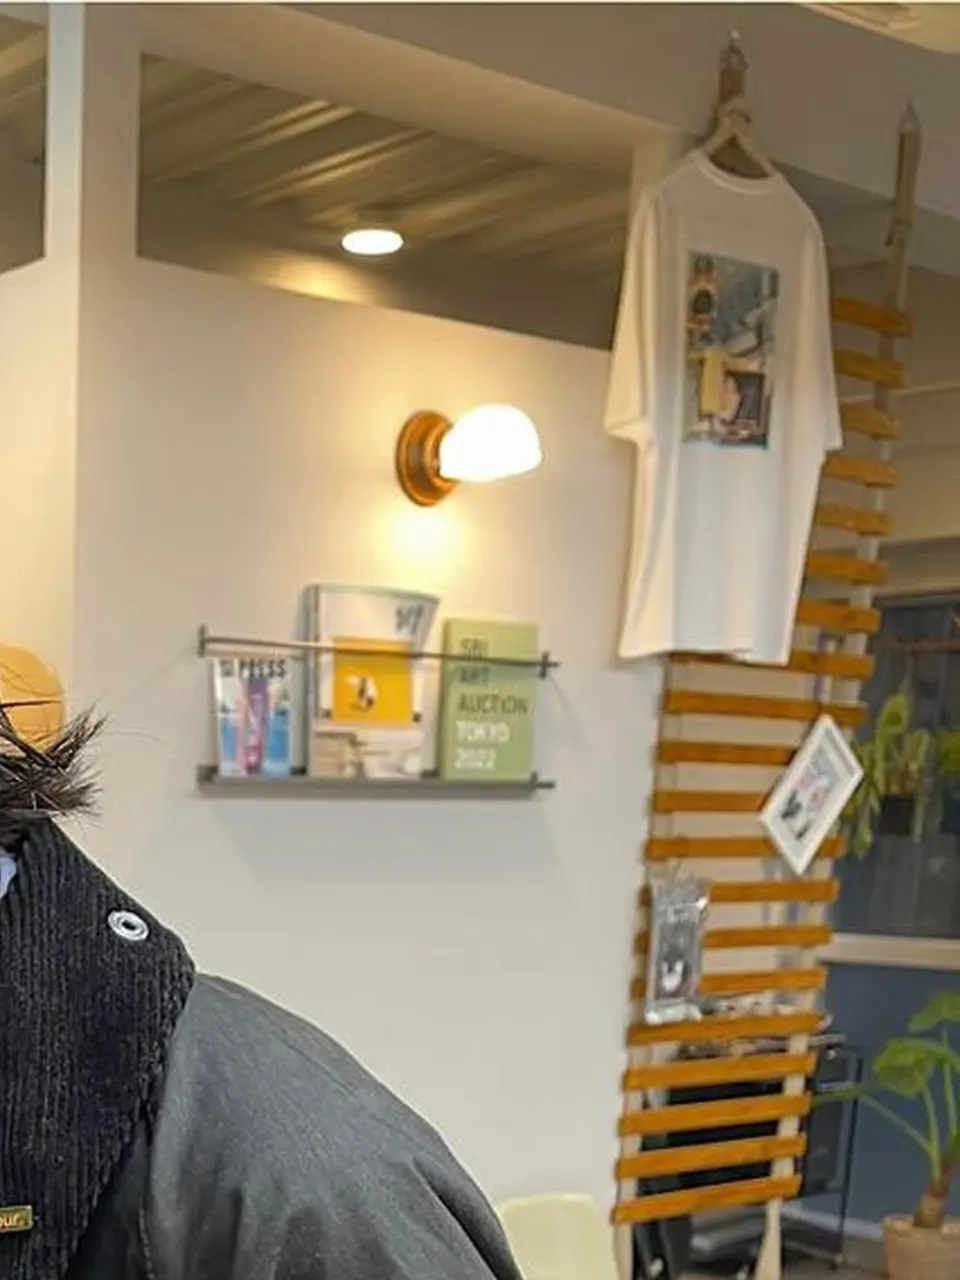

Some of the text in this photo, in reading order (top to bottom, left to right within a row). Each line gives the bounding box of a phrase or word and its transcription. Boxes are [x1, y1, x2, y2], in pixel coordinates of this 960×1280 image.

[457, 692, 529, 715] AUCTION
[455, 720, 511, 742] TOKYO
[454, 746, 497, 770] 2022
